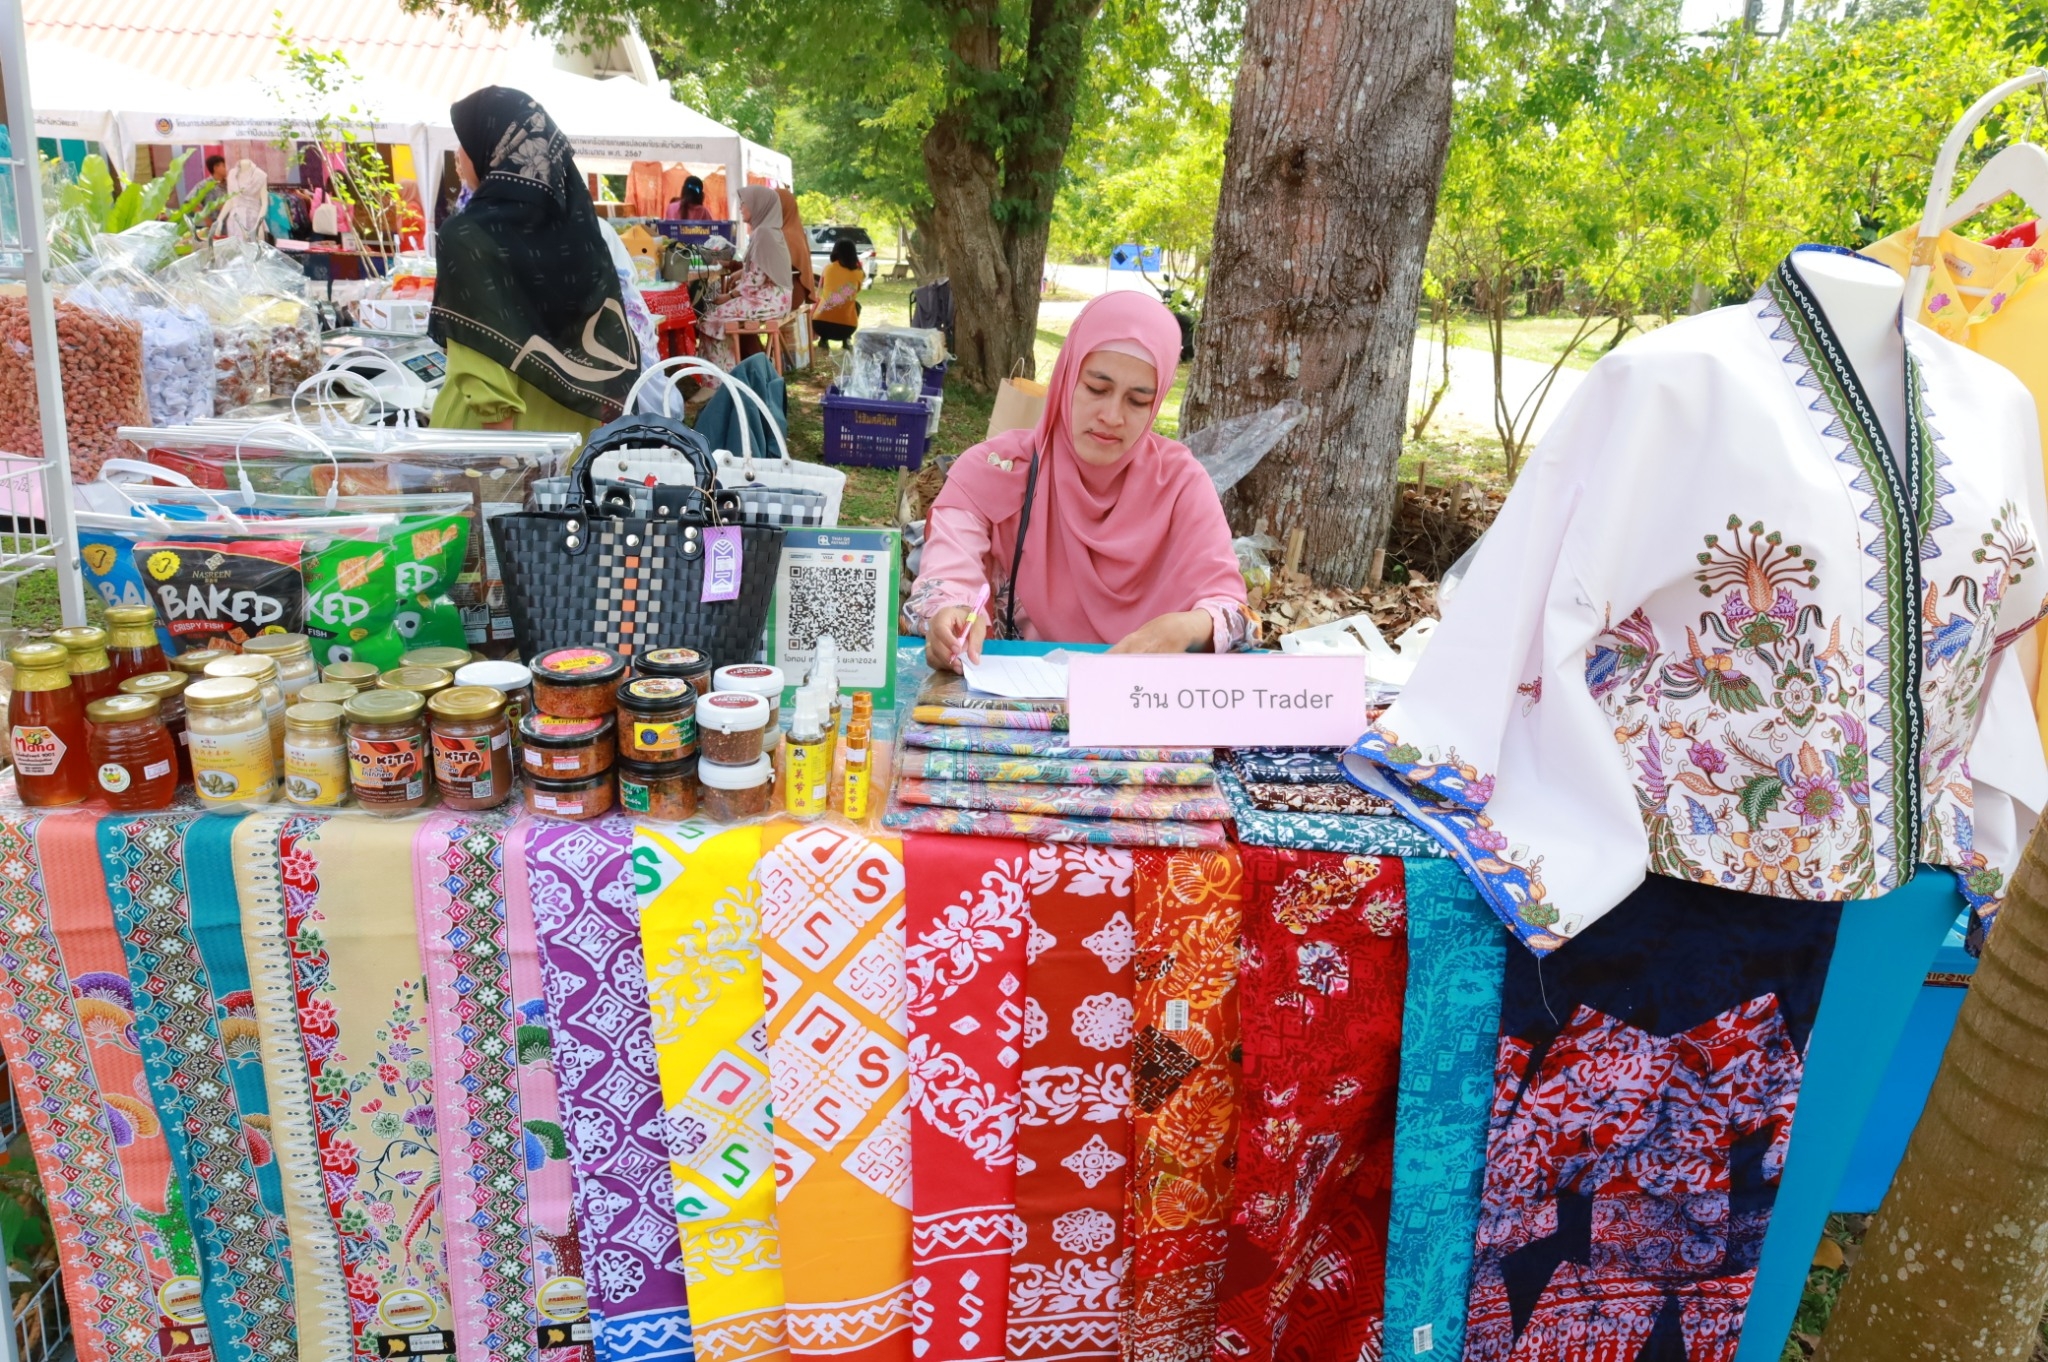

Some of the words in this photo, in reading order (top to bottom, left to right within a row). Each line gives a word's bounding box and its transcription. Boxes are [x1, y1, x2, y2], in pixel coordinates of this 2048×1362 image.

[192, 570, 232, 579] NASREEN
[157, 583, 283, 626] BAKED
[173, 622, 201, 633] CRISPY
[204, 622, 224, 630] FISH
[307, 627, 328, 637] FISH
[1129, 684, 1169, 709] ร้าน
[1177, 688, 1245, 709] OTOP
[1252, 688, 1334, 709] Trader
